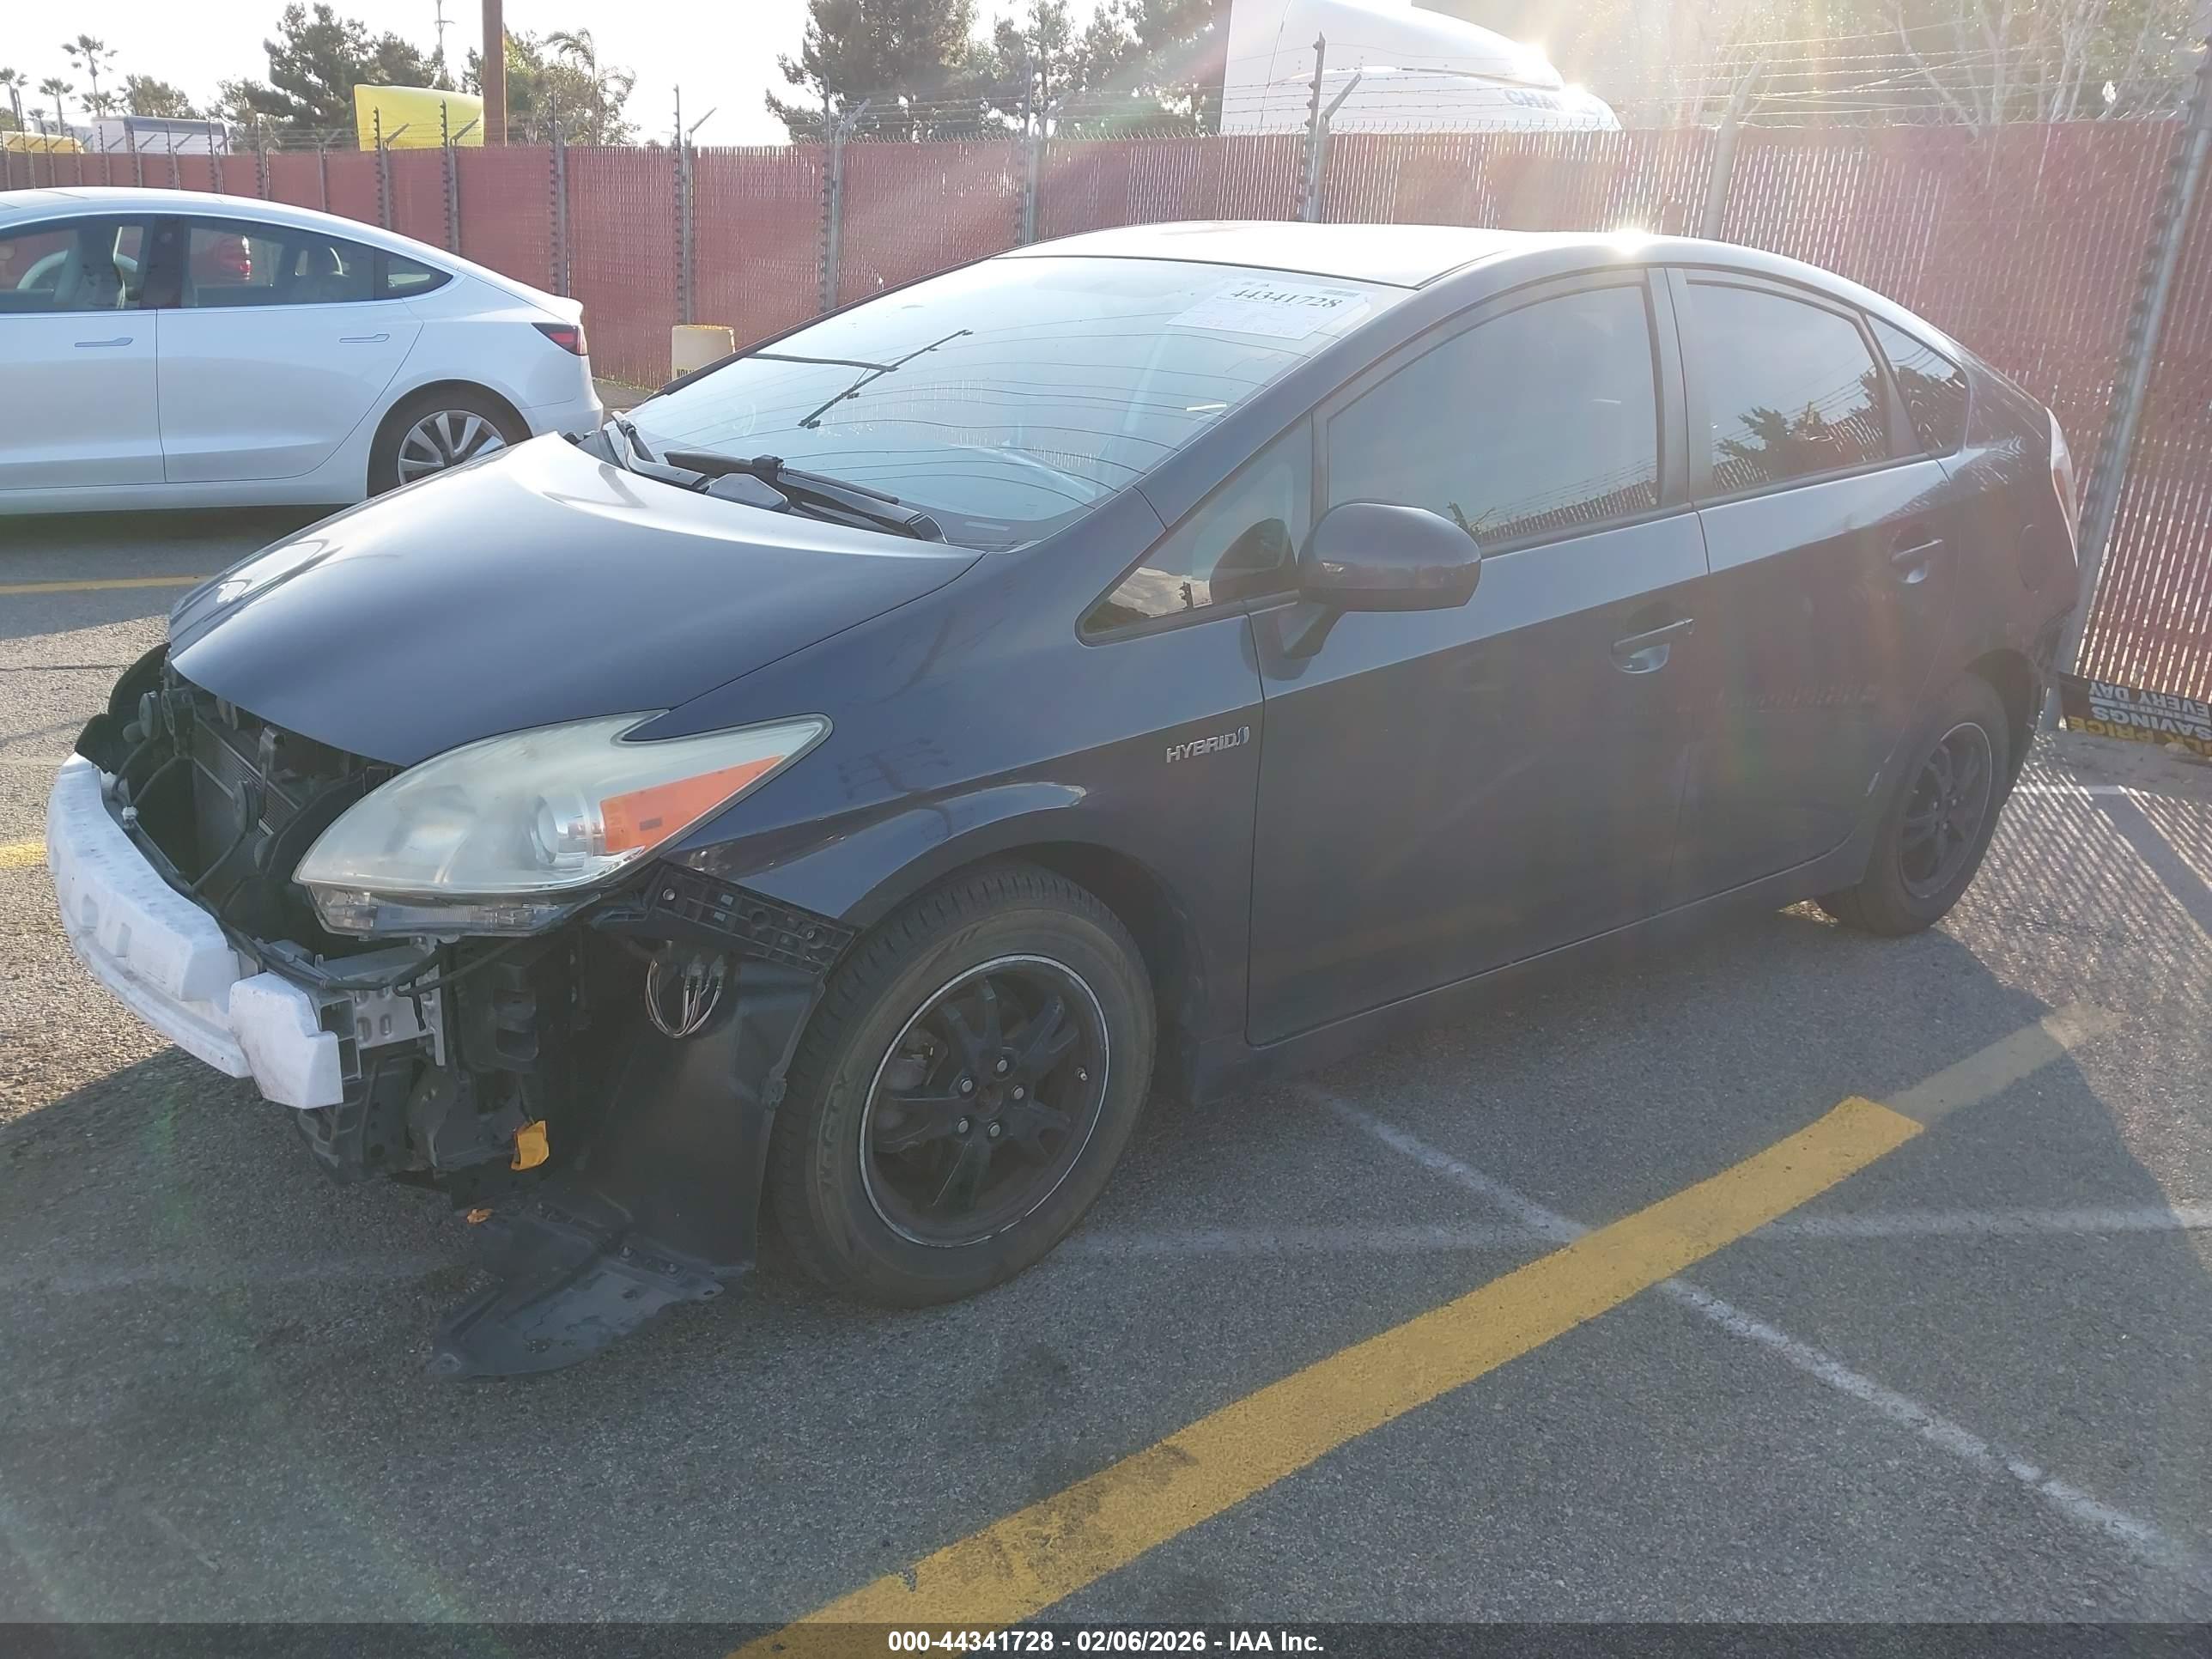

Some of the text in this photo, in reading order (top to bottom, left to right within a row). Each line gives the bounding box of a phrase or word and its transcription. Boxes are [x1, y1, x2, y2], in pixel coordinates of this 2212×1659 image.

[1231, 289, 1343, 308] 44341728
[2088, 681, 2130, 702] DAY
[2138, 690, 2210, 718] EVERY
[2068, 716, 2154, 742] PRICE
[2092, 706, 2212, 740] SAVINGS
